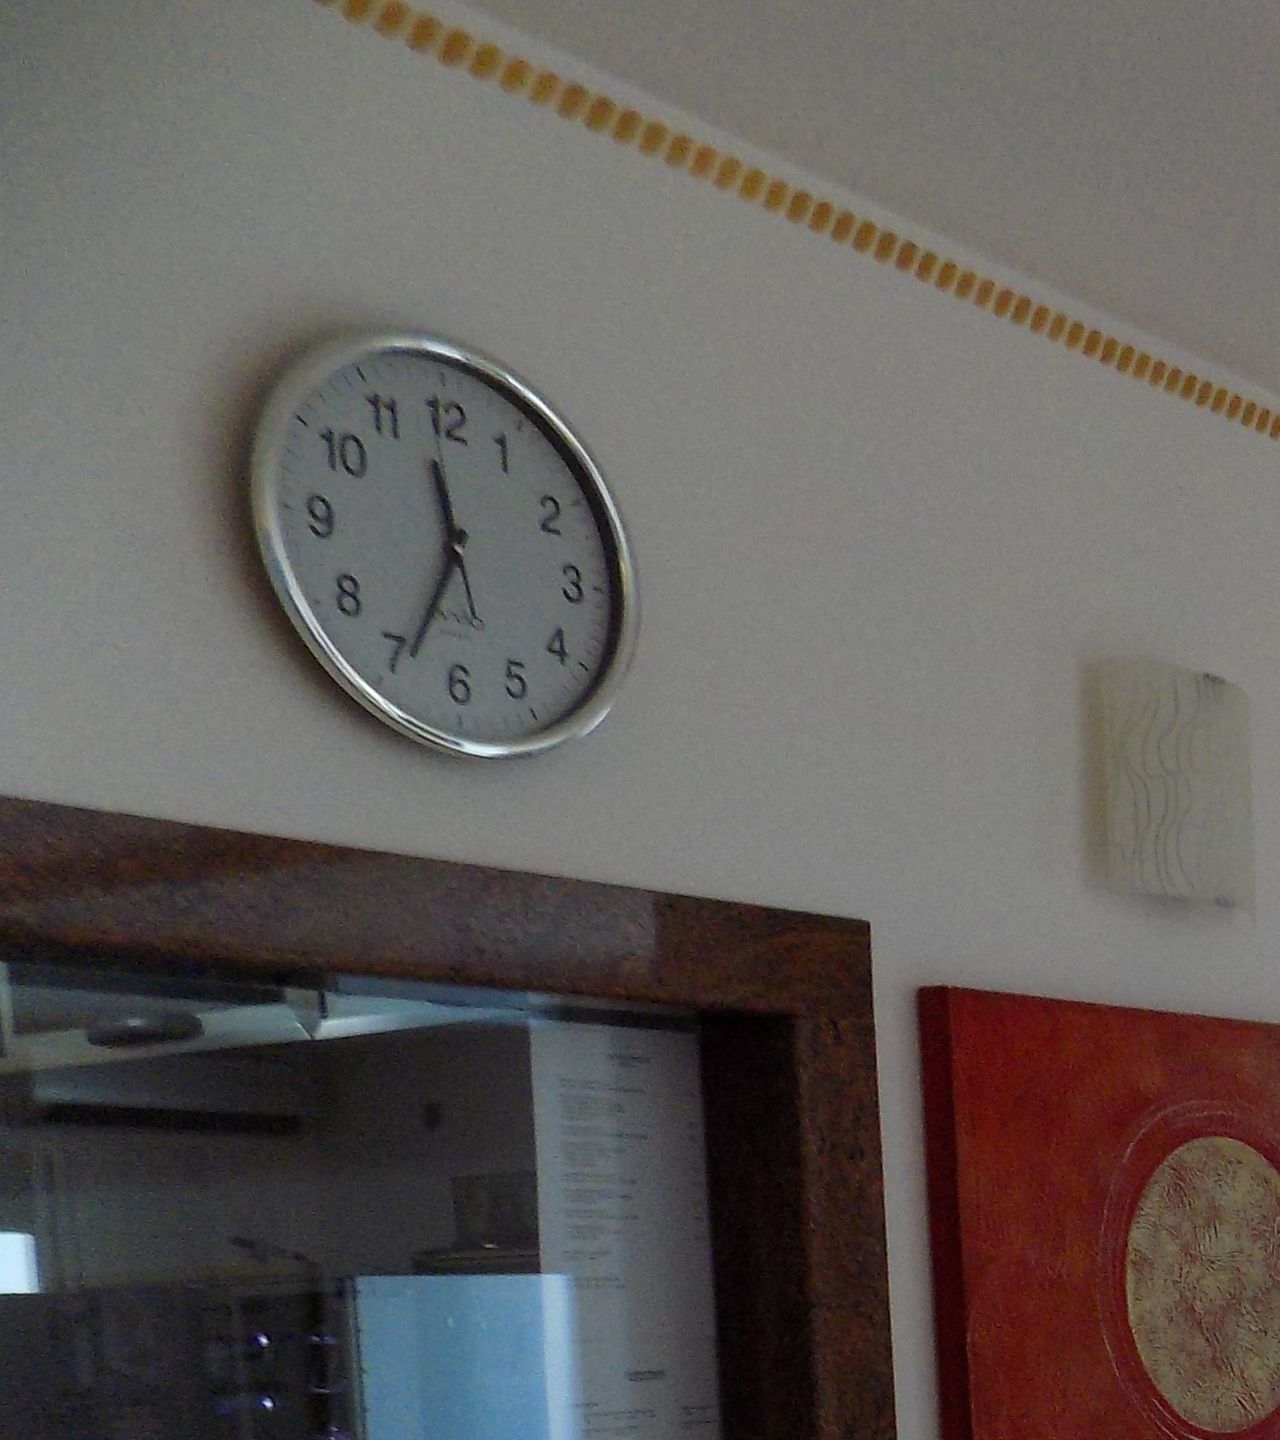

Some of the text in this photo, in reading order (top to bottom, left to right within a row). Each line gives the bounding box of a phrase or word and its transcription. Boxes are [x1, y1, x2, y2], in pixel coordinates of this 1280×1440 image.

[366, 393, 401, 440] 11
[426, 395, 469, 446] 12
[320, 429, 368, 478] 10
[493, 432, 511, 474] 1
[306, 494, 336, 539] 9
[539, 495, 561, 536] 2
[336, 573, 361, 617] 8
[562, 563, 584, 604] 3
[382, 631, 408, 674] 7
[547, 627, 568, 666] 4
[448, 663, 471, 705] 6
[505, 660, 528, 700] 5
